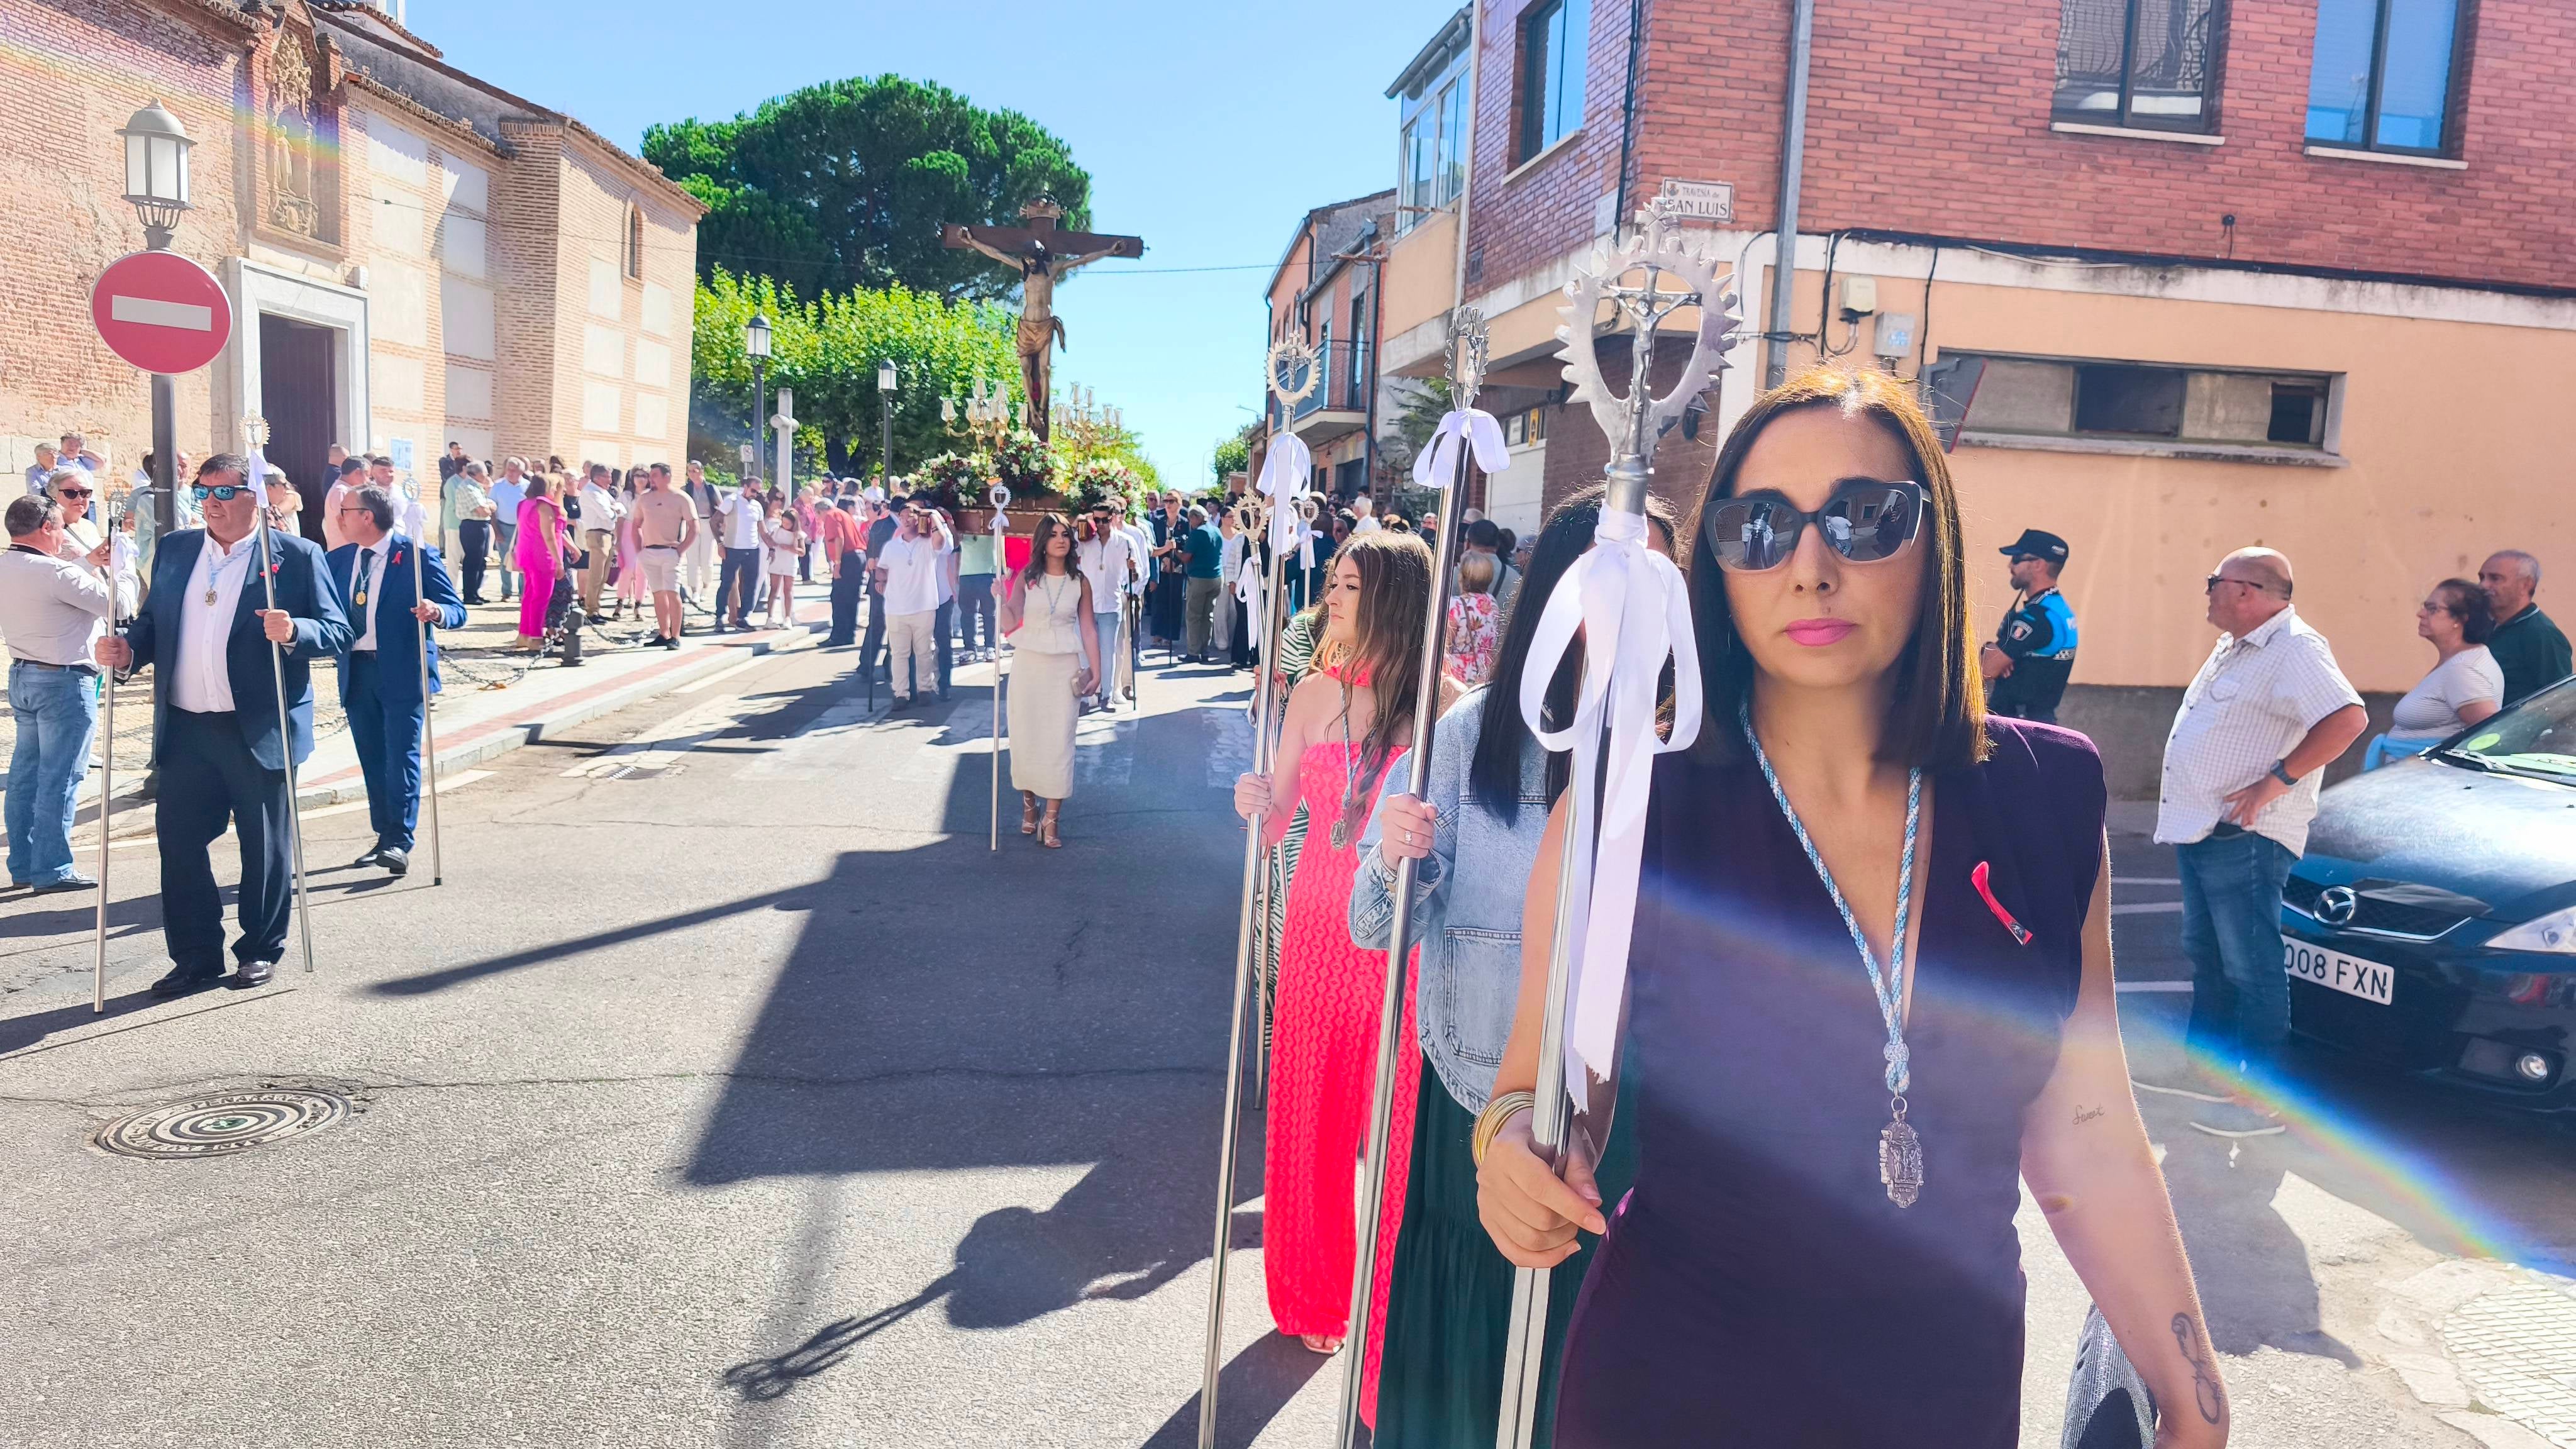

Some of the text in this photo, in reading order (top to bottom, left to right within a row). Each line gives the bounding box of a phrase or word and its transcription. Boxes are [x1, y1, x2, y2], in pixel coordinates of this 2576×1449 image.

[1667, 199, 1728, 216] SAN LUIS
[2284, 944, 2388, 999] 008 FXN
